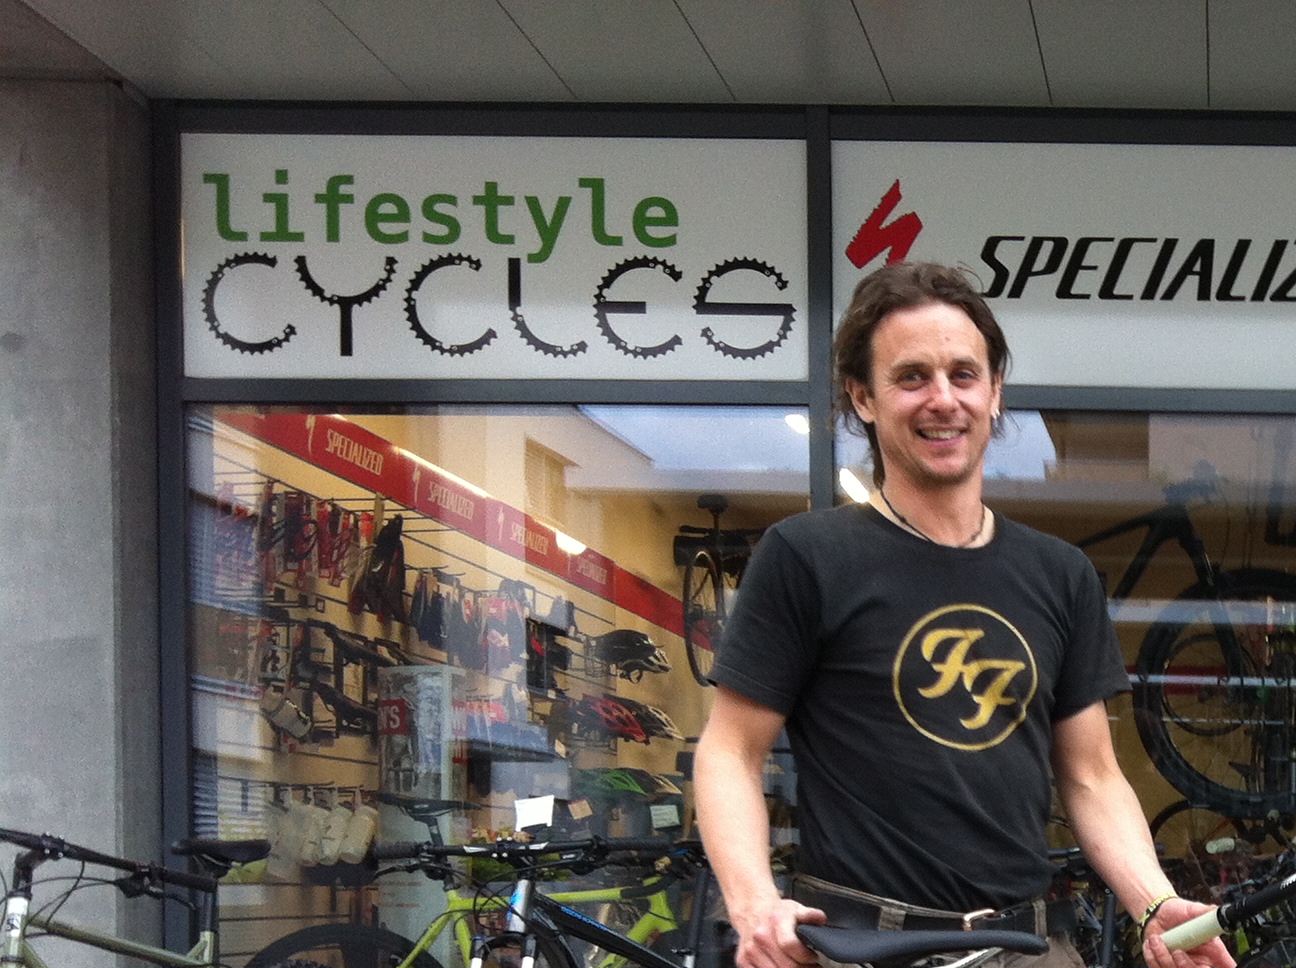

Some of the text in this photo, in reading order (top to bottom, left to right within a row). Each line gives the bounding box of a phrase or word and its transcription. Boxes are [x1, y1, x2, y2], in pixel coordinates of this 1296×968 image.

[203, 169, 680, 263] lifestyle
[202, 251, 797, 361] CYCLES
[326, 428, 385, 476] SPECIALIZED
